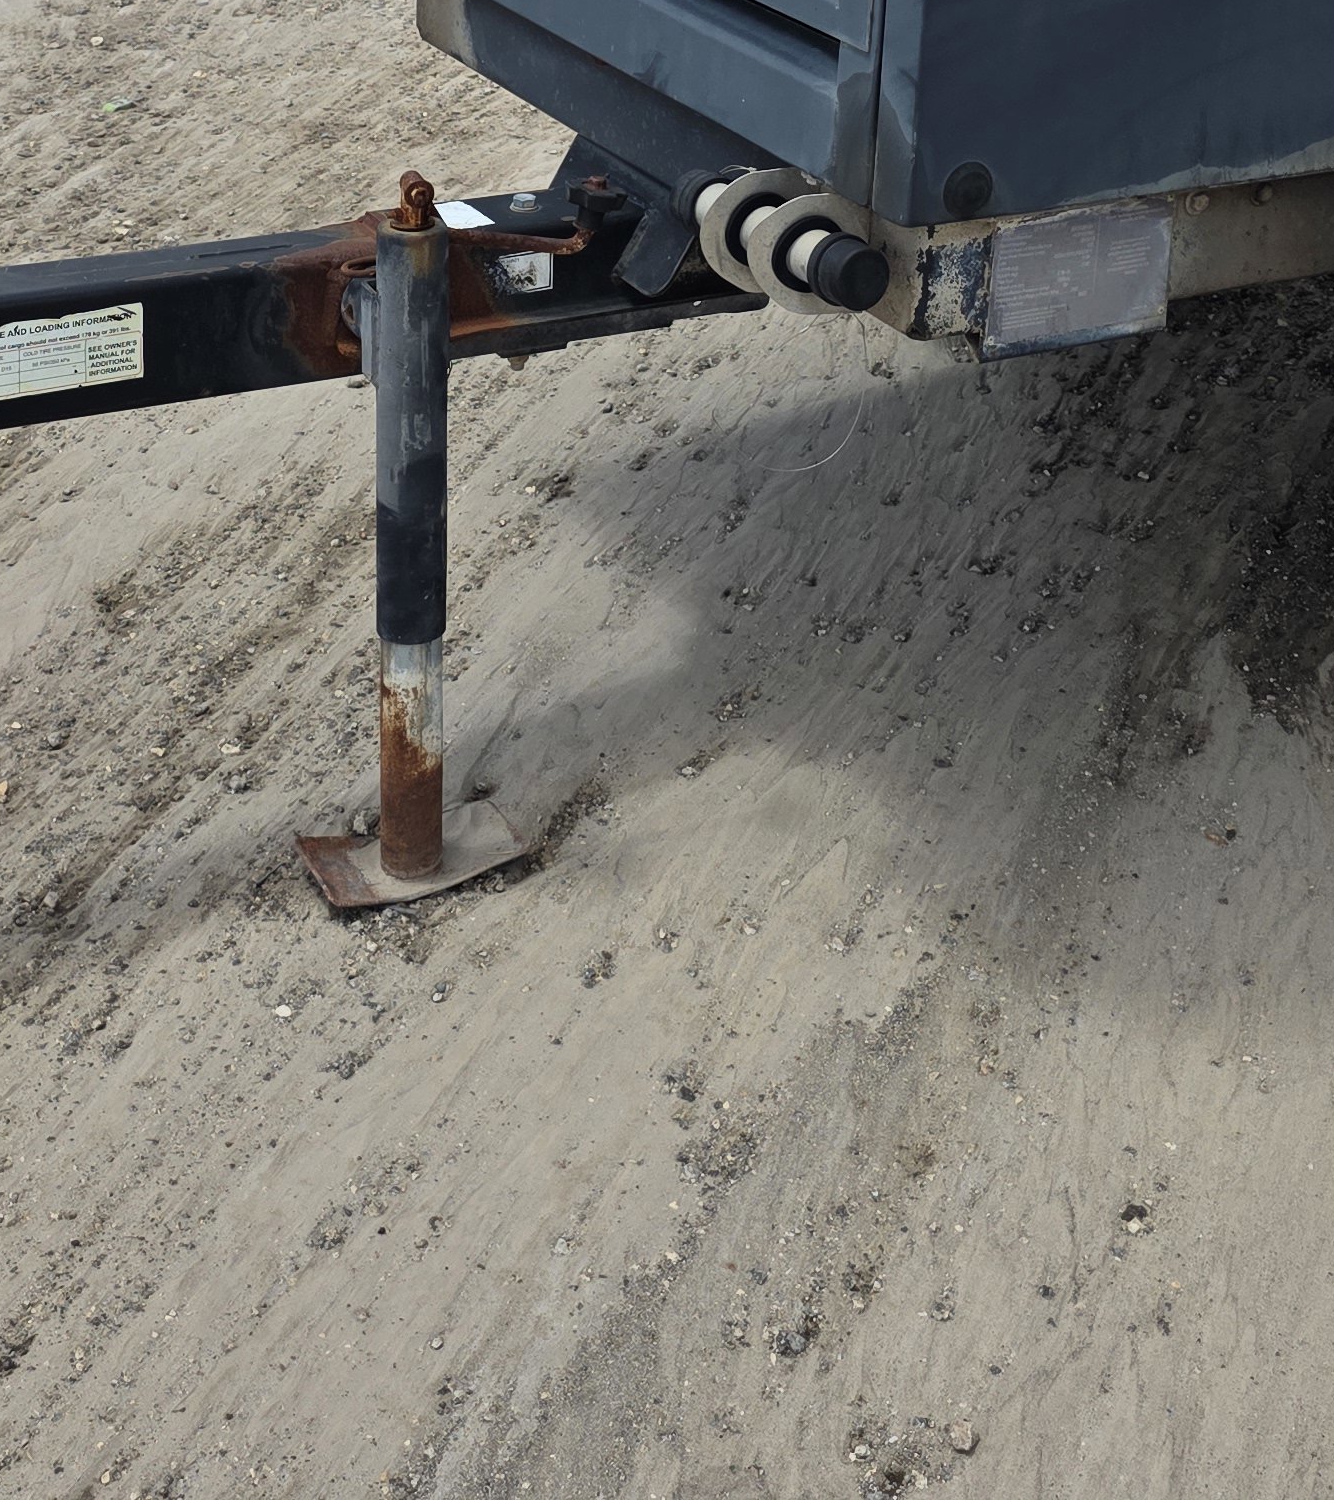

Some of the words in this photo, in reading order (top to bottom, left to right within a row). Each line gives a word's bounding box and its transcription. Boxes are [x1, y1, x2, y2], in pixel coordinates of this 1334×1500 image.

[7, 327, 27, 337] AND
[29, 321, 70, 334] LOADING
[72, 313, 132, 328] INFORMAON
[88, 345, 102, 353] SEE
[104, 340, 137, 351] OWNER'S
[88, 351, 119, 361] MANUAL
[120, 347, 136, 356] FOR
[89, 363, 138, 376] INFORMATION
